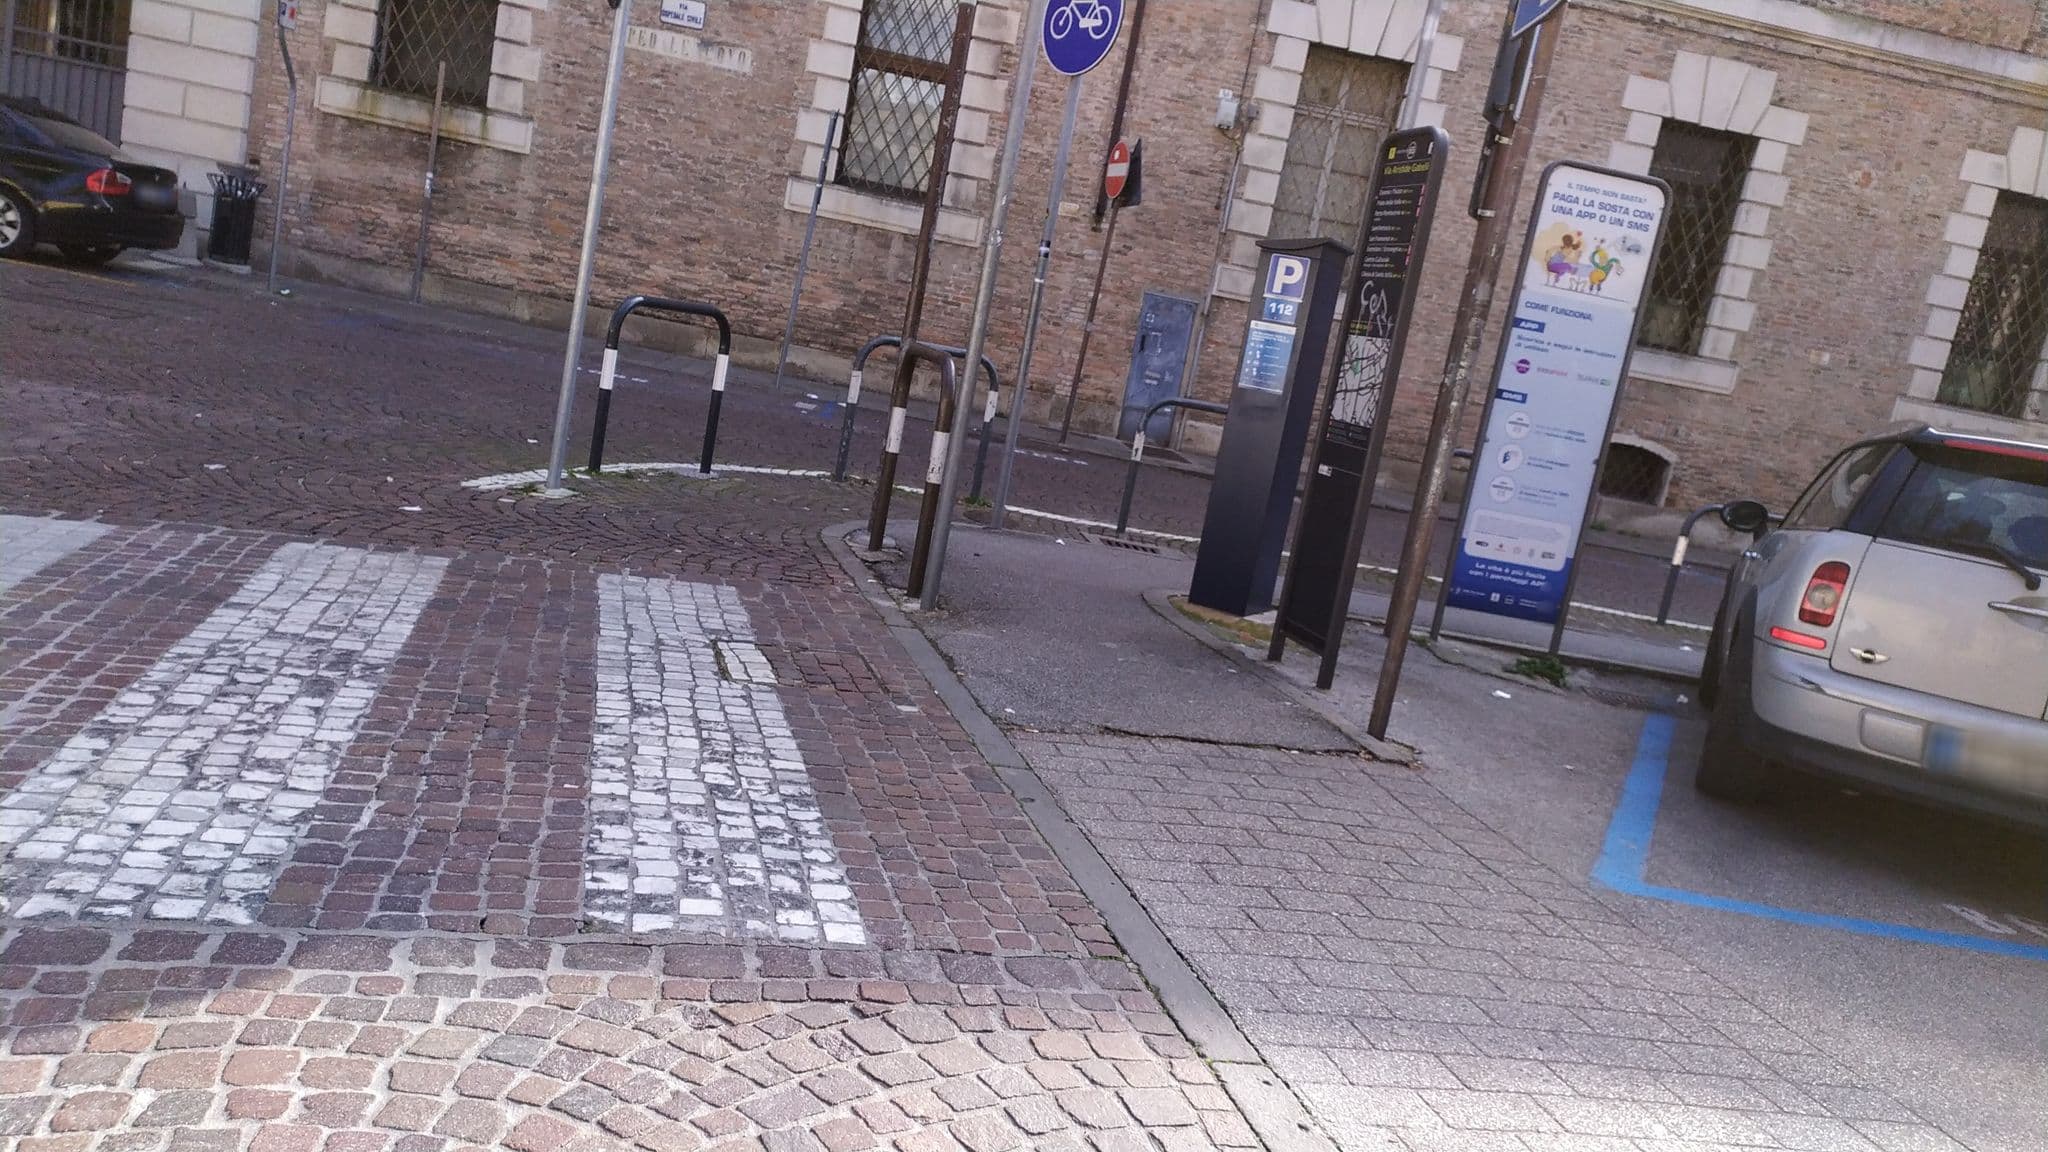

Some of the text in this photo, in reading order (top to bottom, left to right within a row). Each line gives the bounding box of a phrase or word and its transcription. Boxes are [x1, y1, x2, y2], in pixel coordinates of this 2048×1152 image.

[1575, 184, 1600, 194] TEMPO
[1602, 189, 1618, 198] NON
[1552, 191, 1656, 221] PAGA LA SOSTA CON
[1551, 203, 1650, 232] UNA APP O UN SMS
[1271, 256, 1304, 294] P
[1269, 302, 1294, 316] 112
[1524, 300, 1548, 312] COME
[1519, 321, 1540, 330] APP
[1475, 562, 1486, 570] La
[1487, 564, 1503, 572] vita
